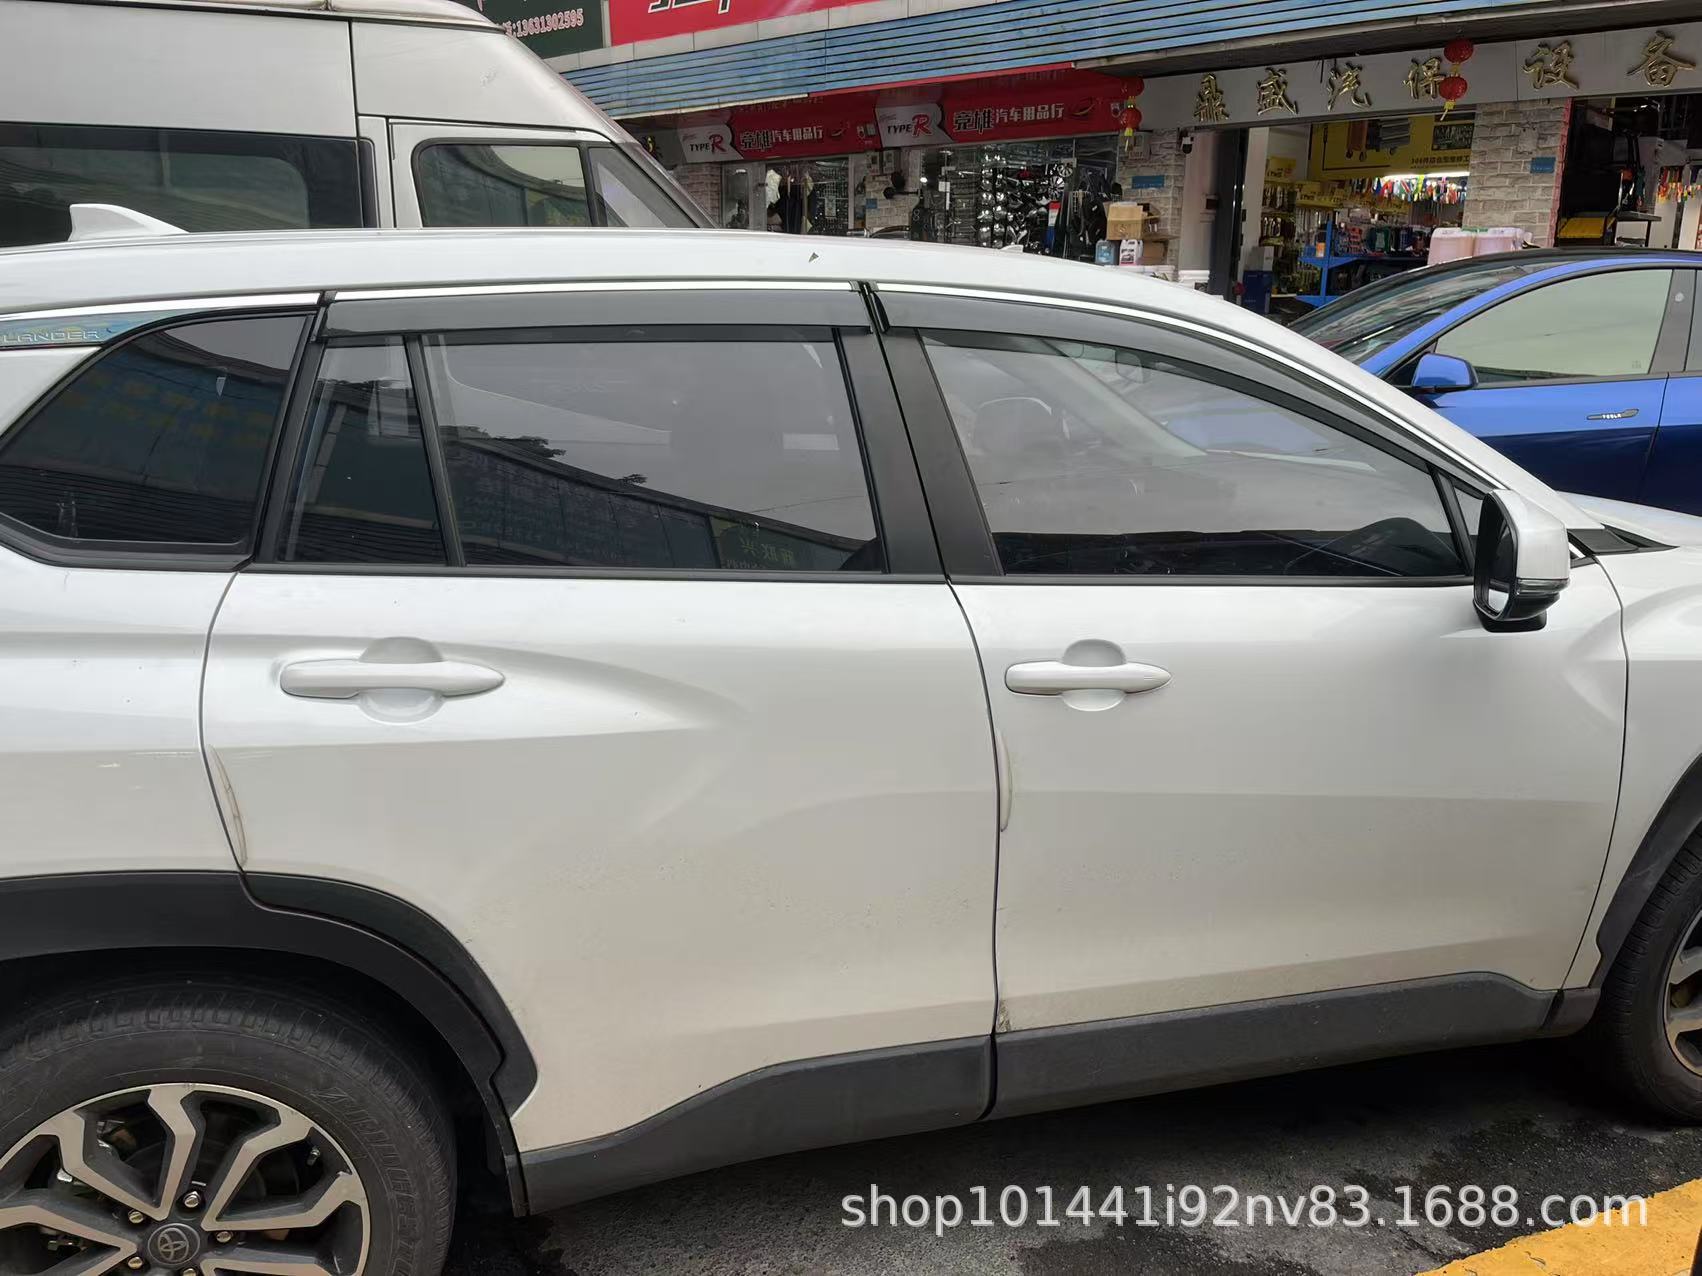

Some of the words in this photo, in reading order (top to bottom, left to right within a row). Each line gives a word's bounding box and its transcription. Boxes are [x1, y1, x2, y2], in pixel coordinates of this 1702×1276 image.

[887, 124, 912, 135] TYPE
[912, 114, 932, 137] R
[690, 142, 709, 152] TYPE
[709, 134, 727, 154] R
